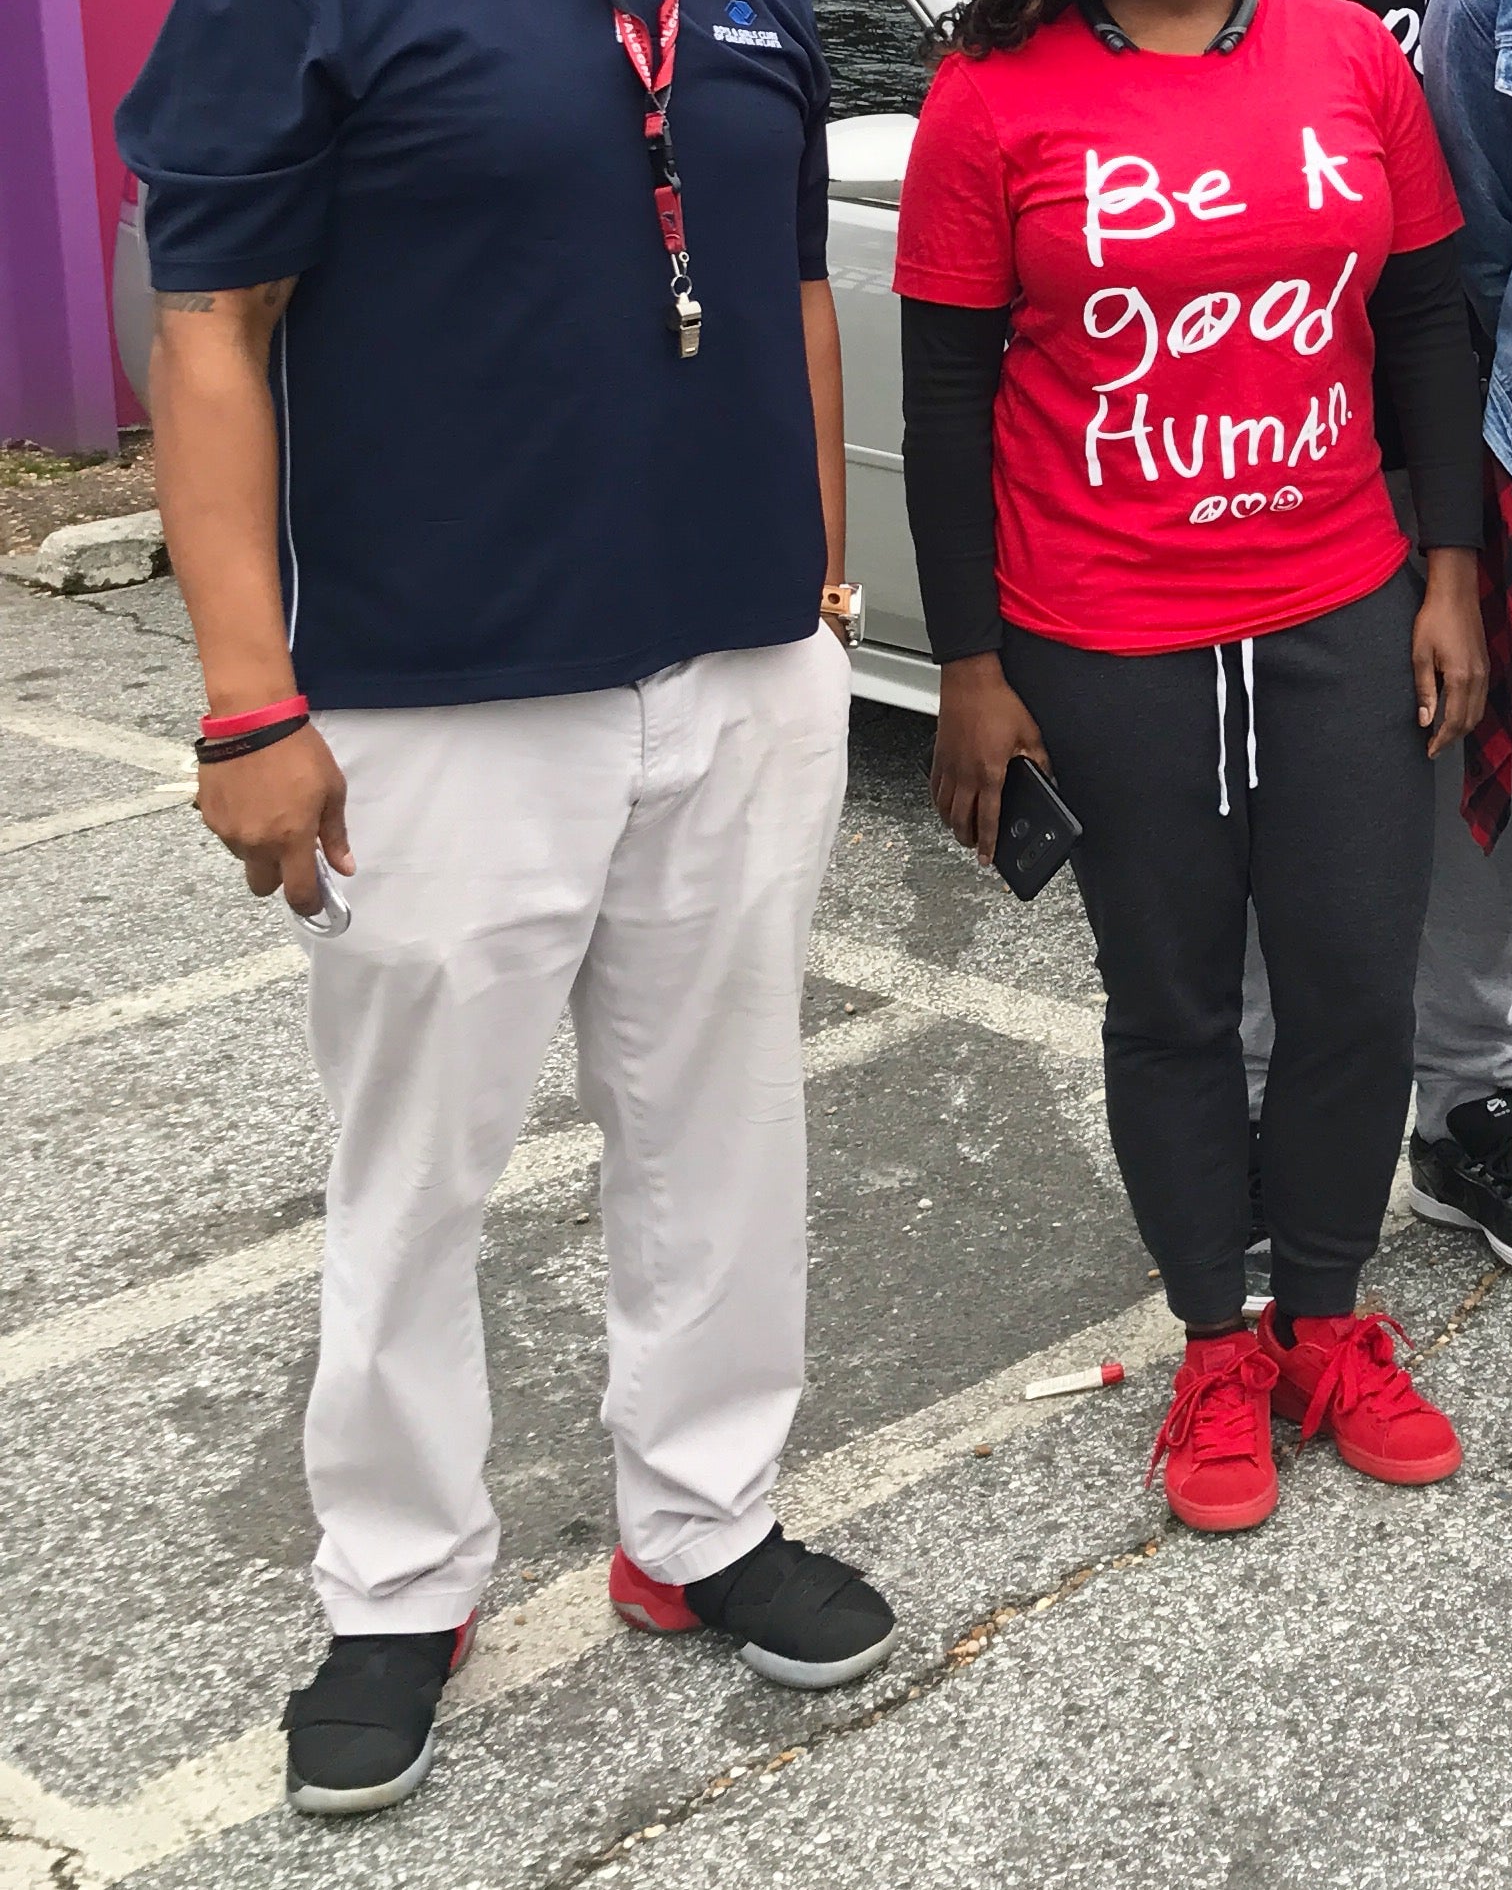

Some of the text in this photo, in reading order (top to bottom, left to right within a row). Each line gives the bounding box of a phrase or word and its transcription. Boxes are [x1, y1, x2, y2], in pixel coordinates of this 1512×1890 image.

[1082, 126, 1363, 267] Be A
[1083, 251, 1358, 392] good
